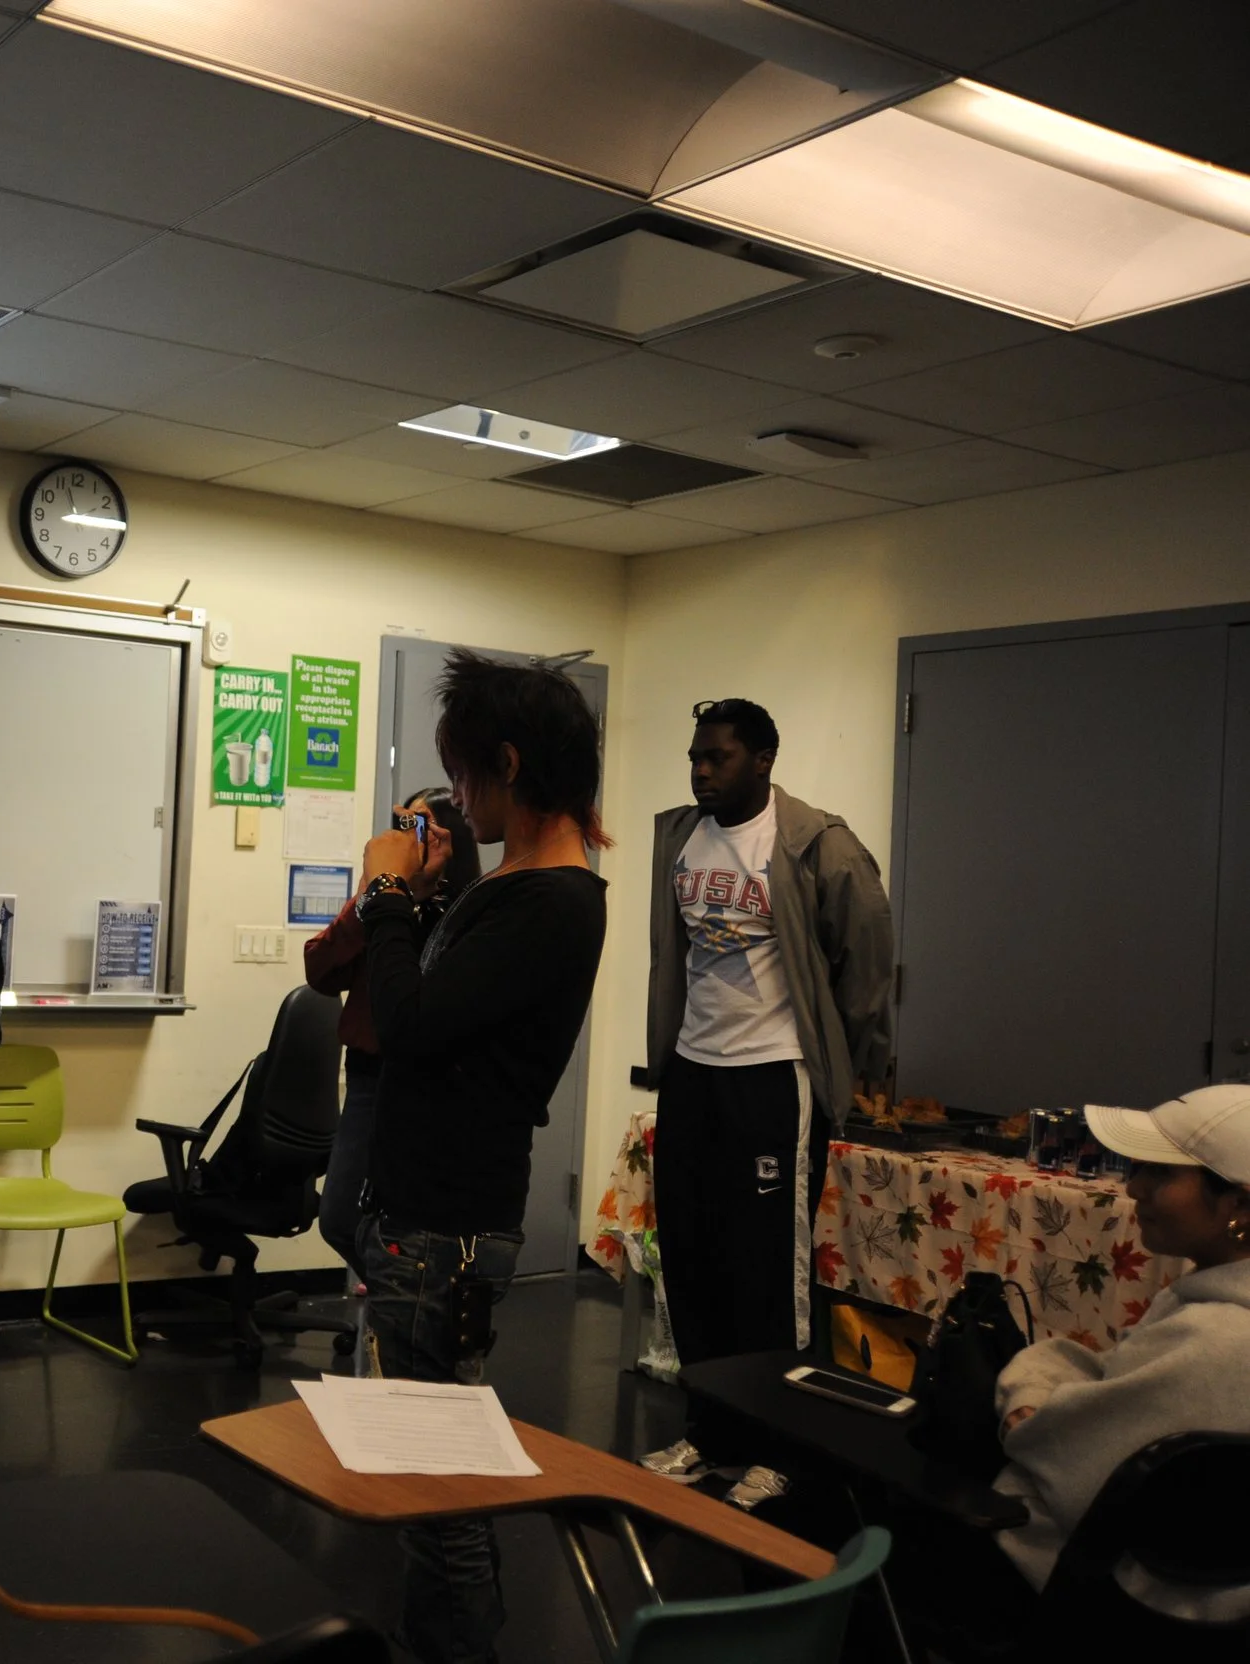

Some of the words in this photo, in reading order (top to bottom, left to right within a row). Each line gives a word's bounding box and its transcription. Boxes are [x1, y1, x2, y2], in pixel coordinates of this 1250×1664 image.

[56, 476, 65, 489] 11
[71, 474, 84, 487] 12
[41, 488, 54, 503] 10
[102, 496, 110, 509] 2
[35, 508, 44, 521] 9
[39, 529, 49, 542] 8
[100, 537, 110, 549] 4
[54, 545, 62, 558] 7
[87, 549, 97, 561] 5
[69, 553, 78, 566] 6
[296, 659, 323, 672] Please
[325, 666, 356, 676] dispose
[221, 673, 260, 691] CARRY
[312, 674, 322, 682] all
[324, 677, 350, 686] waste
[312, 684, 321, 692] in
[322, 685, 337, 694] the
[219, 693, 258, 710] CARRY
[261, 696, 283, 713] OUT
[301, 694, 350, 706] appropriate
[302, 714, 315, 722] the
[344, 707, 352, 716] in
[676, 869, 772, 918] USA
[755, 1156, 780, 1180] C
